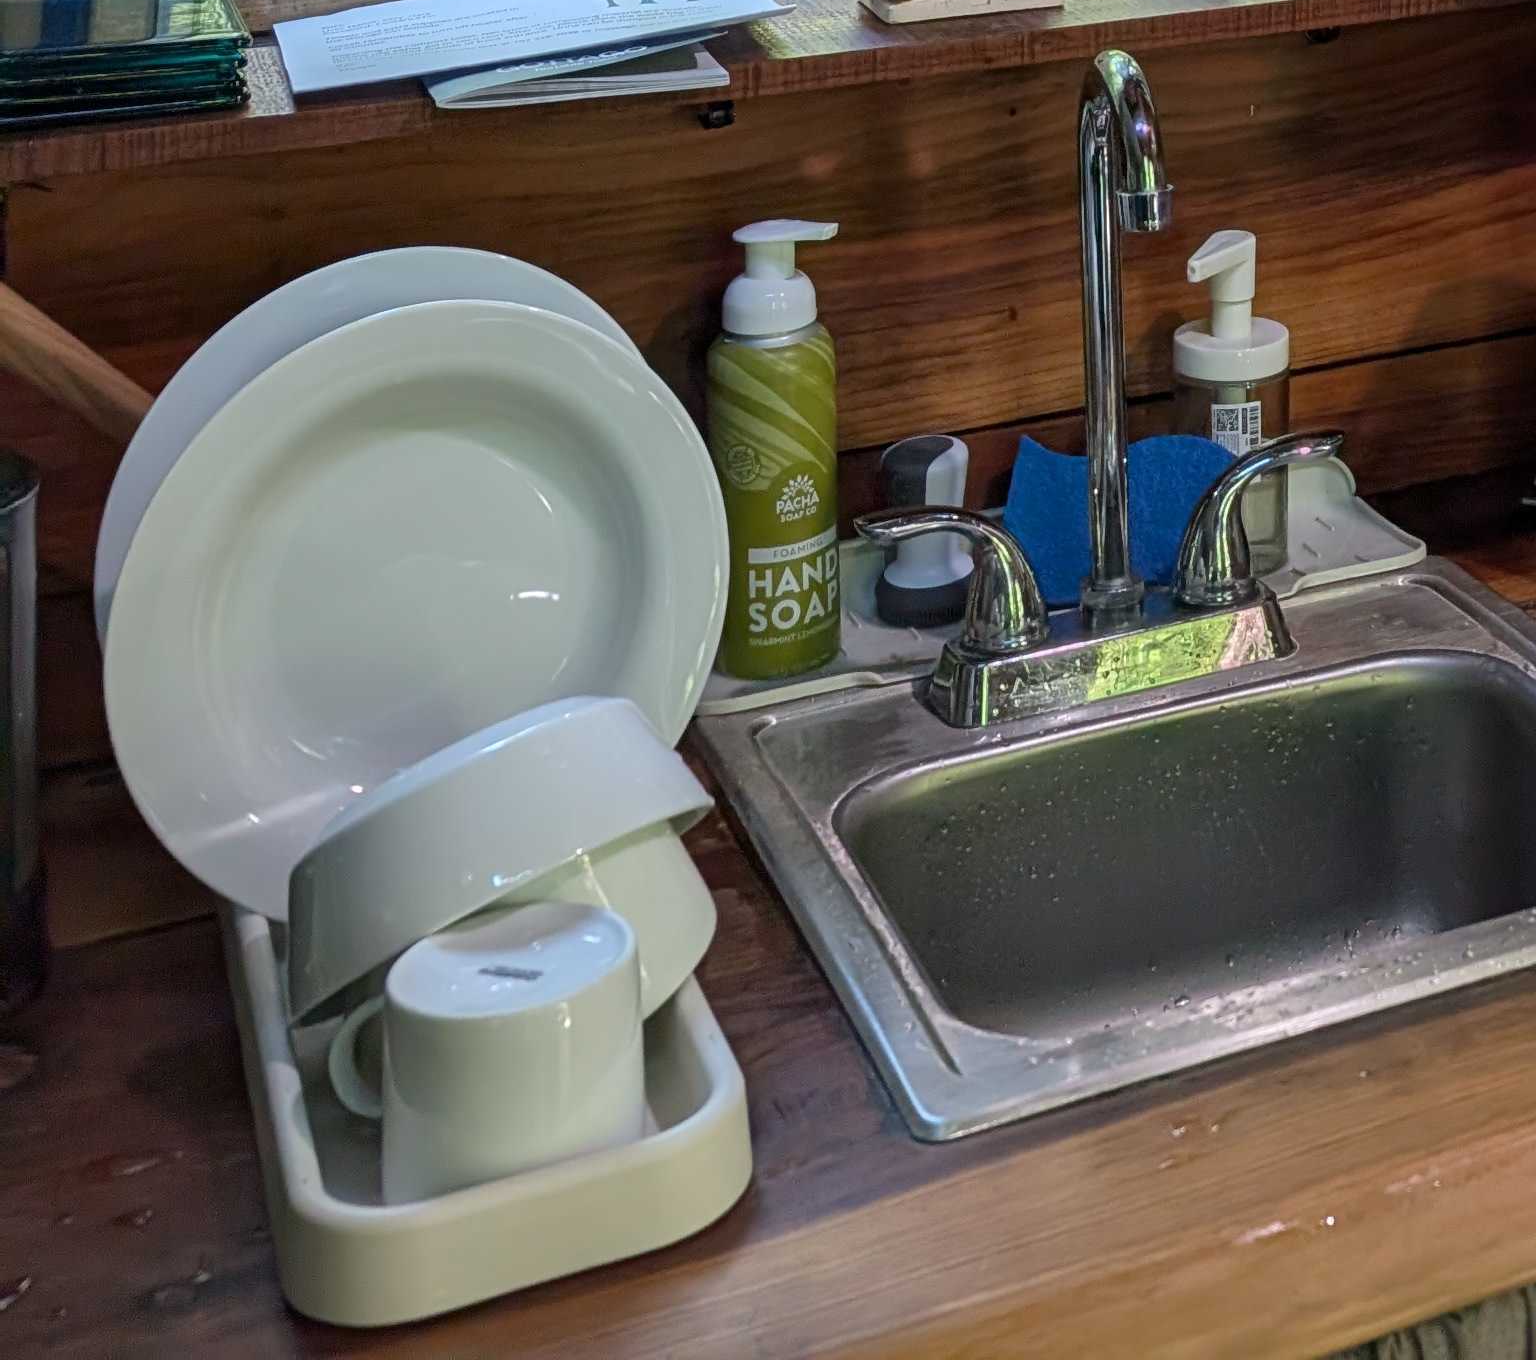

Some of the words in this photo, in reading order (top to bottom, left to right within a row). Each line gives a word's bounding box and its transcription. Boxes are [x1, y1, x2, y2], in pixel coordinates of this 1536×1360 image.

[775, 491, 820, 515] PACHA
[780, 511, 805, 523] SOAP
[805, 506, 817, 516] CO
[773, 539, 823, 560] FOAMING
[748, 547, 838, 599] HAND
[748, 579, 838, 633] SOAP
